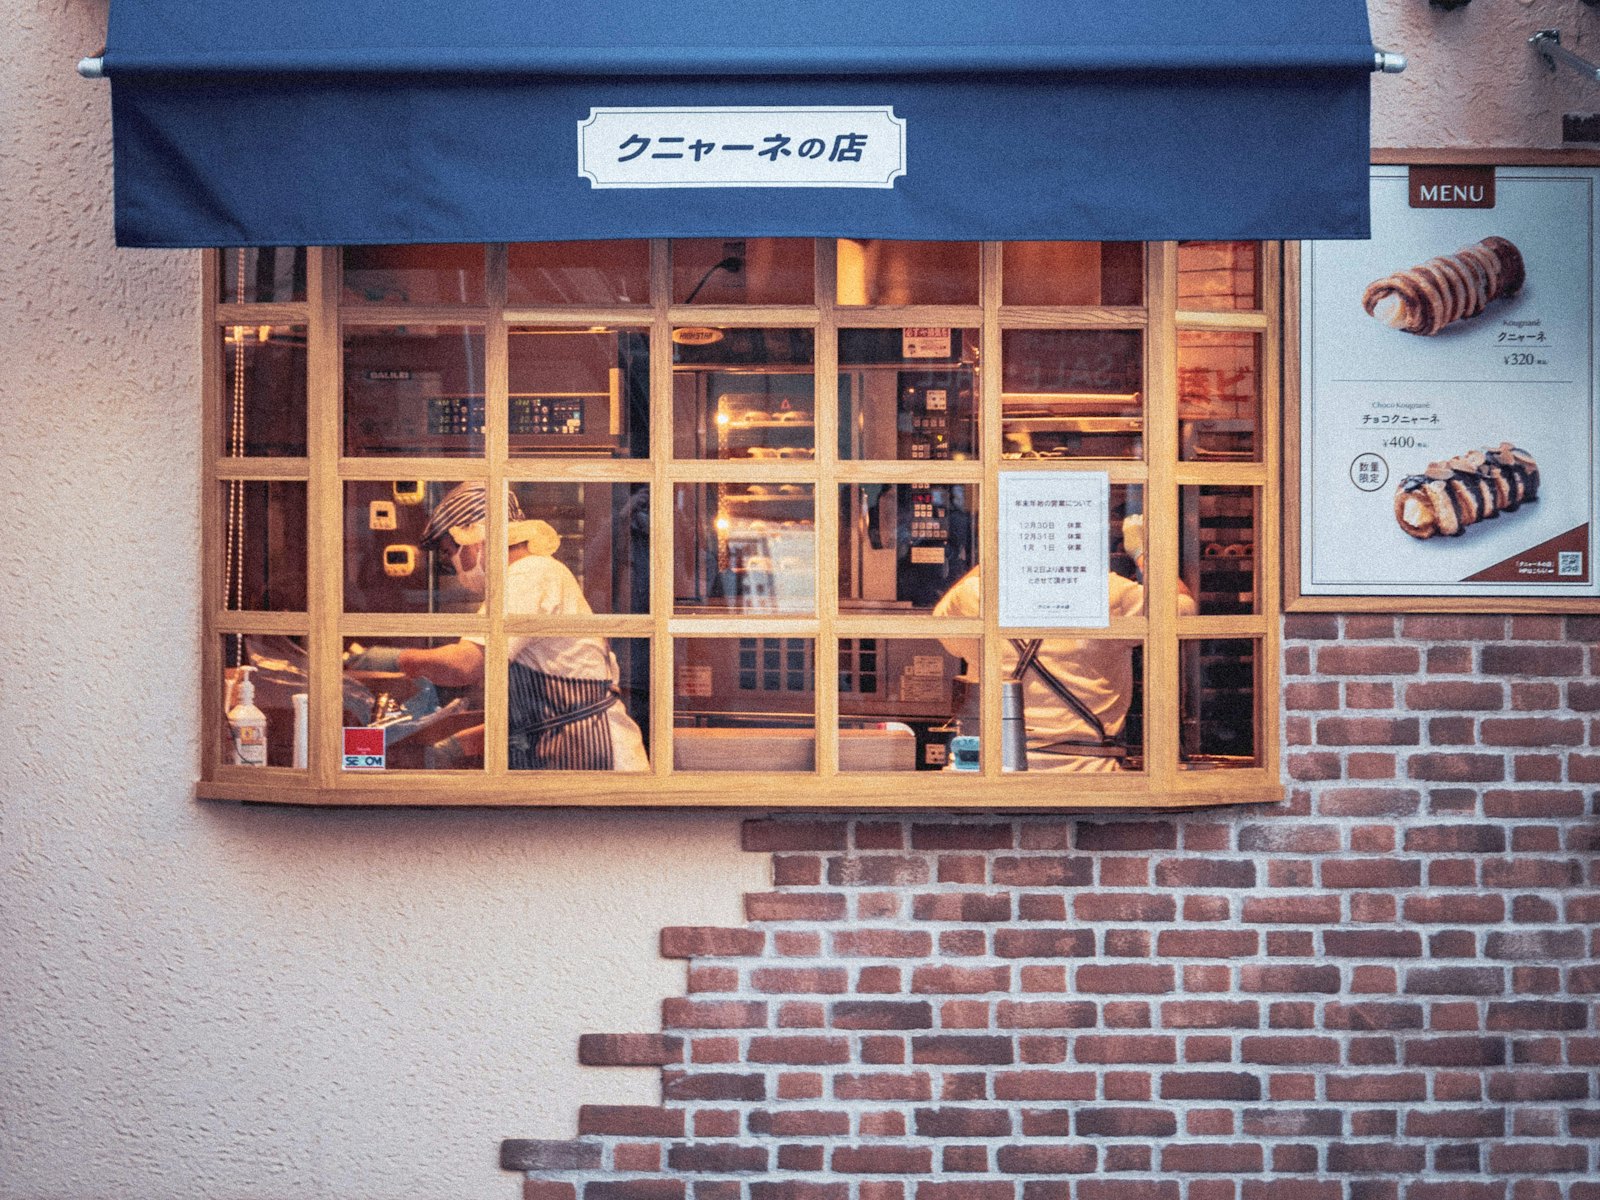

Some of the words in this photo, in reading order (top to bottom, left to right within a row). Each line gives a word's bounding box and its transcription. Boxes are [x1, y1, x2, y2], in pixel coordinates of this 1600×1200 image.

[618, 132, 868, 162] クニャーネの店
[1420, 184, 1484, 202] MENU
[1498, 331, 1547, 342] クニャーネ
[1504, 353, 1534, 365] ¥320
[1362, 413, 1440, 424] チョコクニャーネ
[1383, 436, 1415, 448] ¥400
[1360, 462, 1379, 472] 数量
[1359, 473, 1379, 483] 限定
[1020, 521, 1055, 529] 12月30日
[1020, 532, 1055, 540] 12月31日
[345, 756, 382, 767] SEOM
